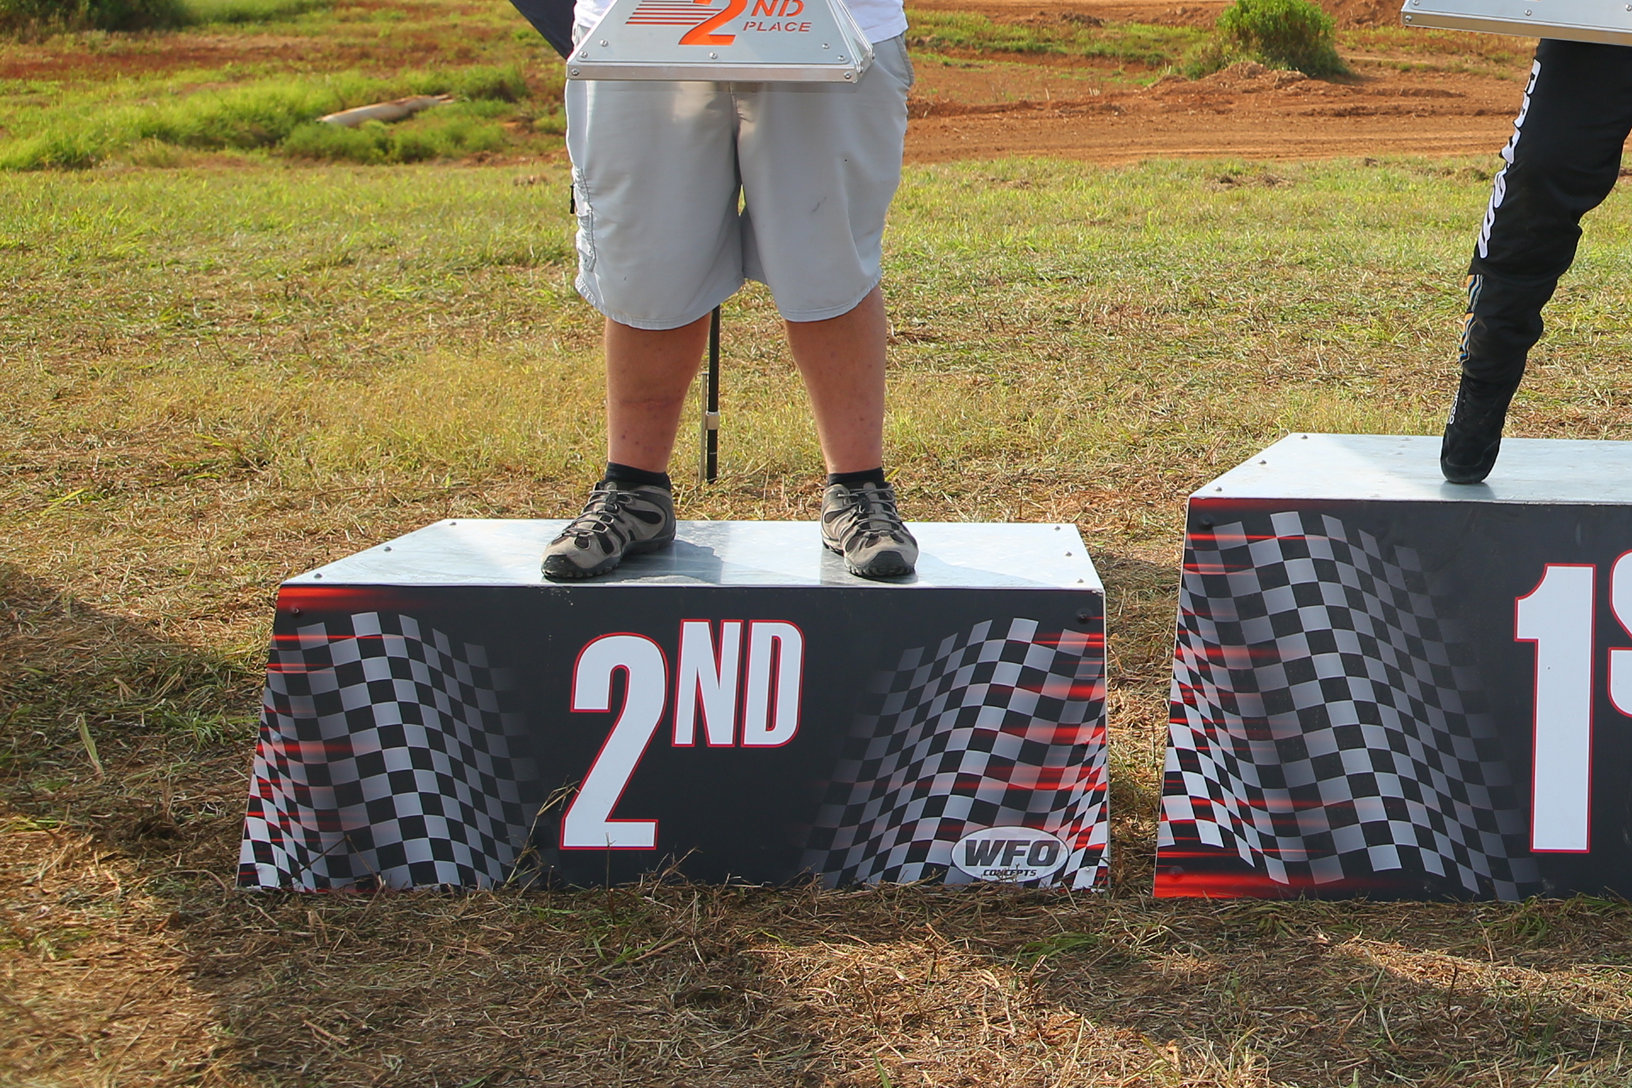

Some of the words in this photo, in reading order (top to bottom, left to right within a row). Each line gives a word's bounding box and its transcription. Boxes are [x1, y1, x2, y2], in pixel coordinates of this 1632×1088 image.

[742, 22, 812, 33] PLACE
[558, 618, 805, 850] 2ND
[965, 839, 1061, 867] WFO
